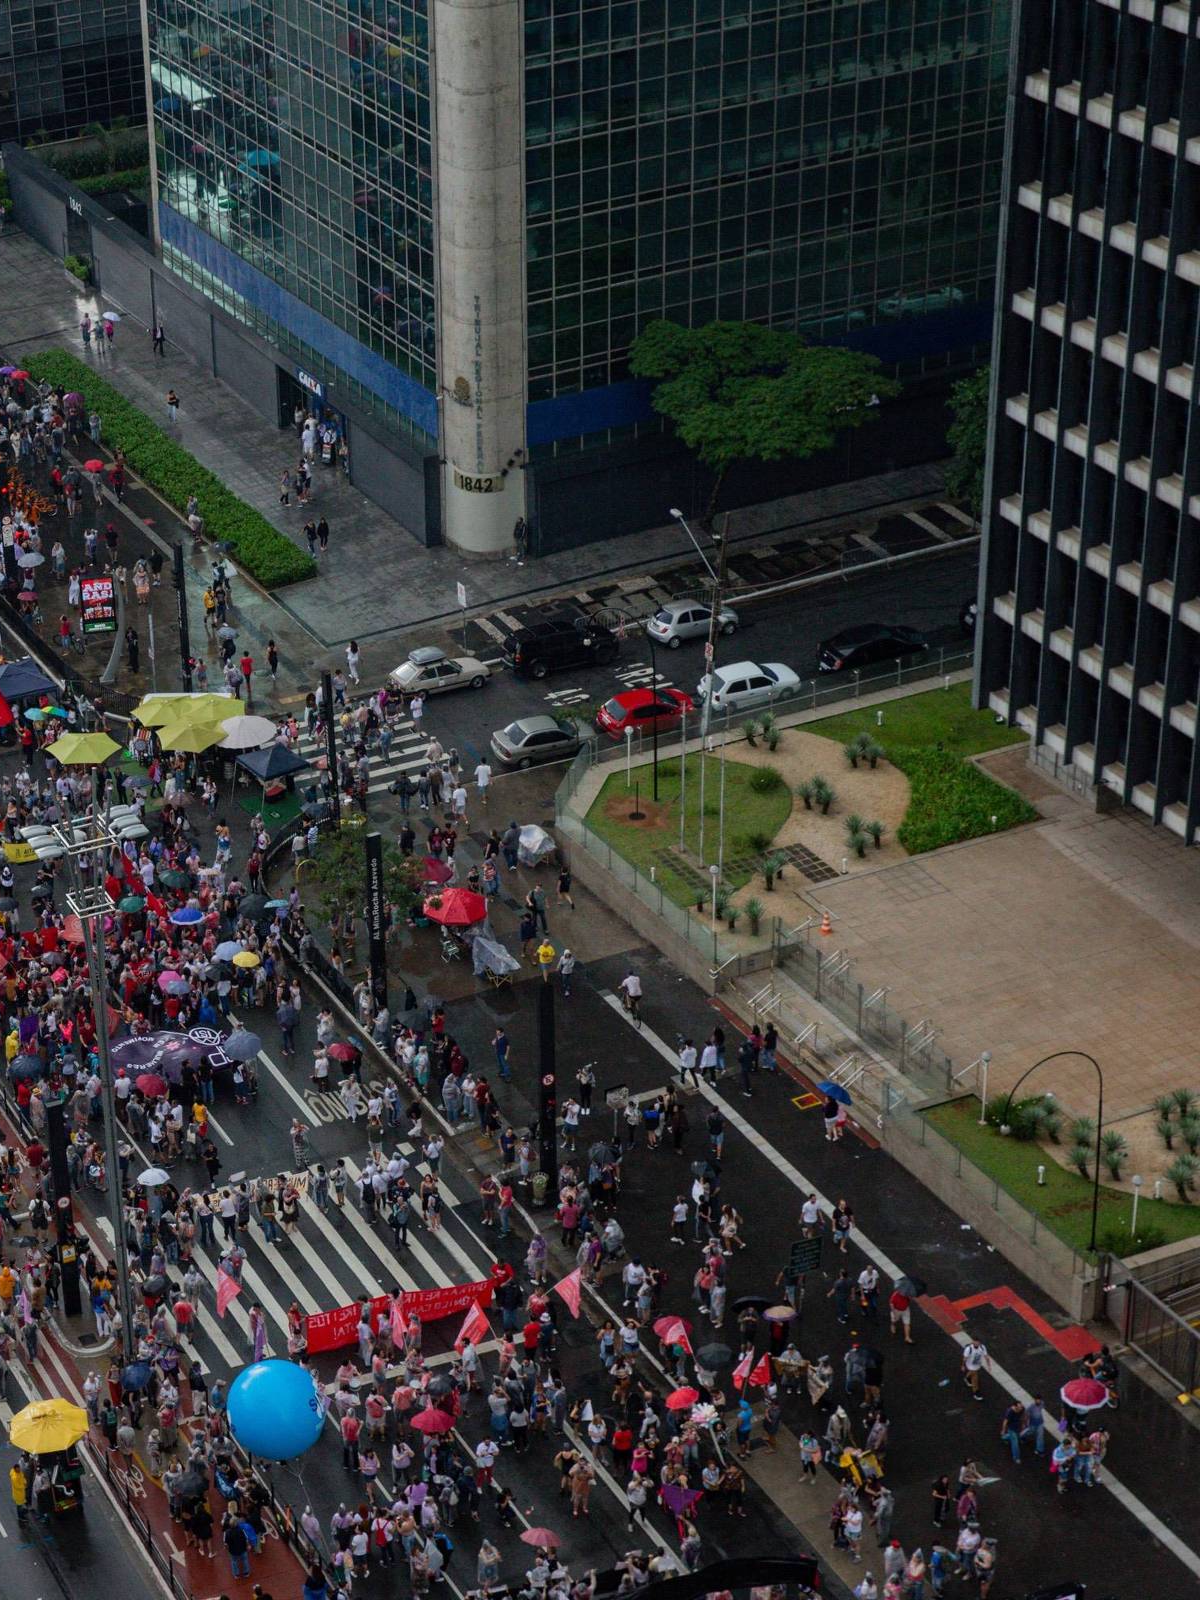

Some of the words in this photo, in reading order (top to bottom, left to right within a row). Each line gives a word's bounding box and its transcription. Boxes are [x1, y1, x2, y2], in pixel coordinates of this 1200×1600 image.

[68, 196, 83, 217] 1842
[298, 371, 322, 397] CAIXA
[459, 475, 494, 493] 1842
